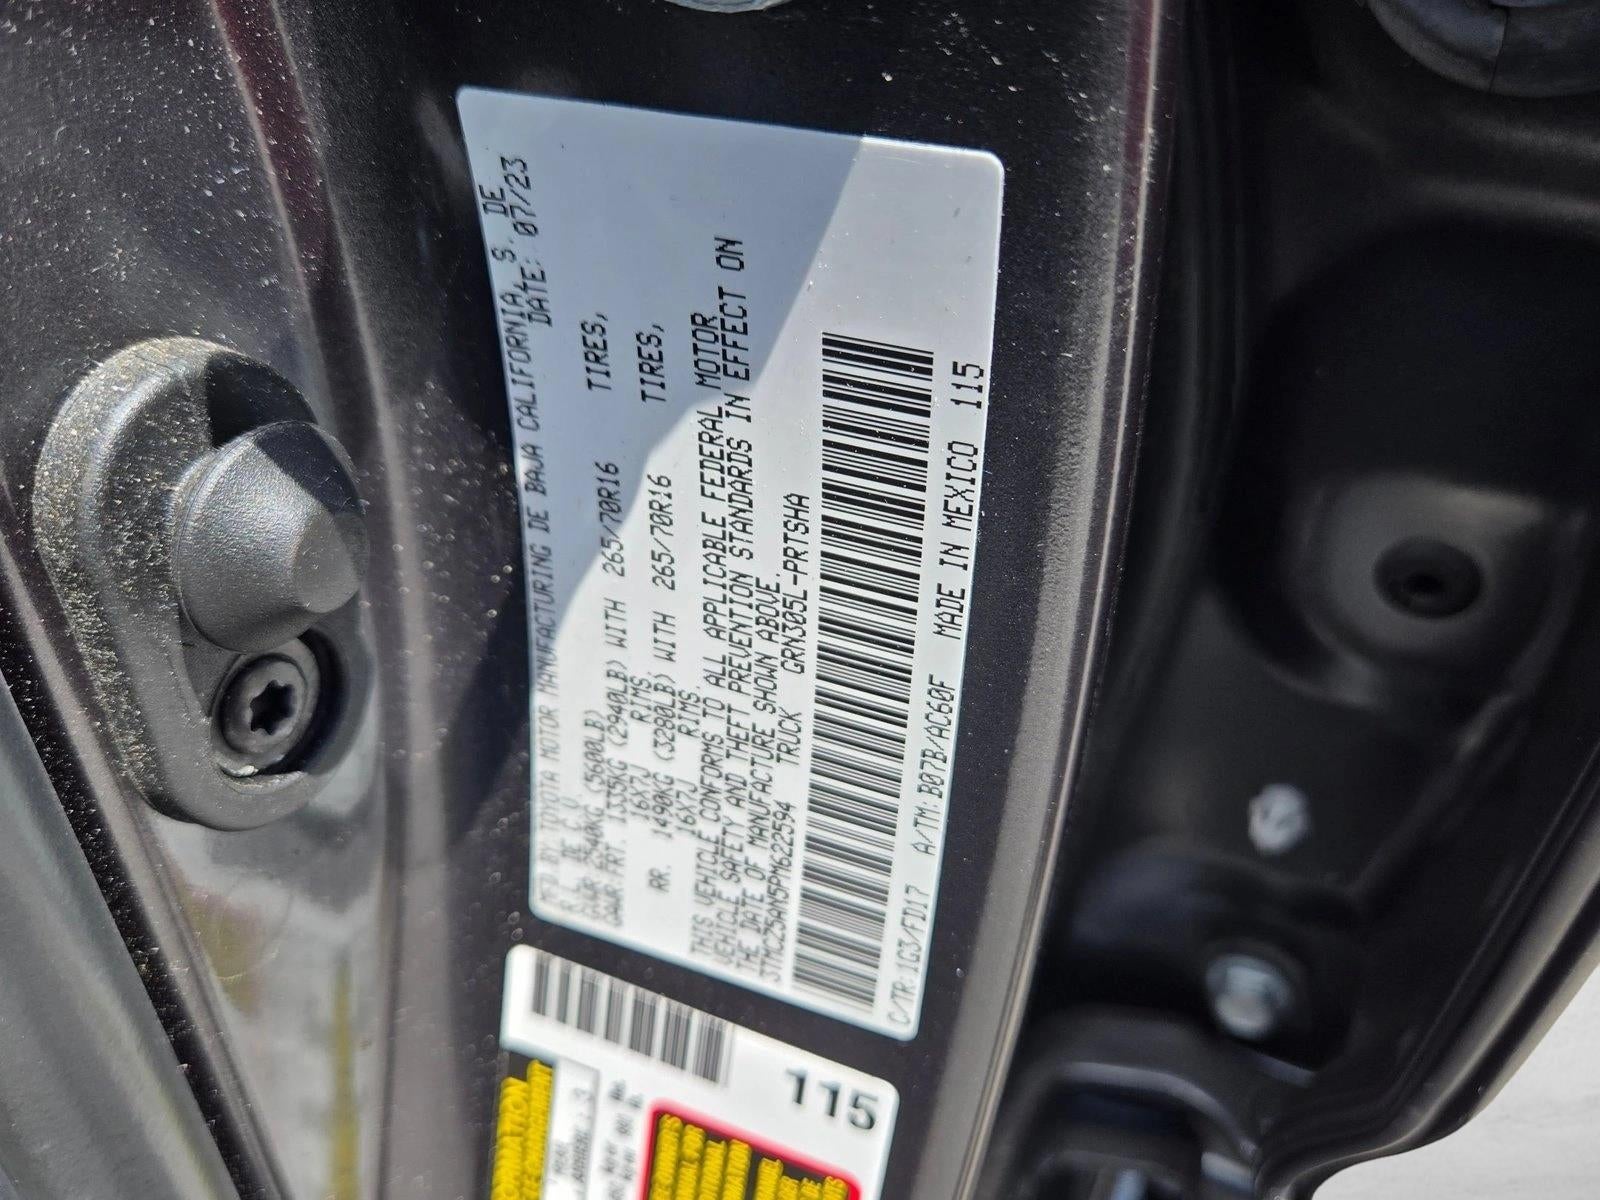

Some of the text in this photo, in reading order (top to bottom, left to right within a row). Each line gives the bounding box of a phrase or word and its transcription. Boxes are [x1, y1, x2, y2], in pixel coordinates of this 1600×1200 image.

[478, 184, 510, 218] DE
[491, 238, 517, 263] S.
[500, 156, 552, 328] DATE: 07/23
[499, 283, 539, 432] CALIFORNIA,
[580, 312, 611, 391] TIRES,
[635, 324, 666, 403] TIRES,
[950, 361, 983, 410] 115
[518, 443, 547, 496] BAJA
[941, 440, 978, 532] MEXICO
[527, 506, 550, 533] DE
[595, 462, 625, 577] 265/70R16
[647, 474, 675, 590] 265/70R16
[939, 541, 970, 571] IN
[529, 546, 558, 697] MANUFACTURING
[603, 597, 627, 648] WITH
[653, 611, 676, 662] WITH
[689, 312, 728, 956] THIS VEHICLE CONFORMS TO ALL APPLICABLE FEDERAL MOTOR
[713, 235, 753, 966] VEHICLE SAFETY AND THEFT PREVENTION STANDARDS IN EFFECT ON
[932, 583, 965, 640] MADE
[538, 704, 560, 760] MOTOR
[605, 660, 628, 747] (2940LB)
[652, 673, 676, 762] (3280LB)
[759, 492, 810, 982] 3TMCZ5AN5PM622594 TRUCK GRN305L-PRTSHA
[582, 710, 606, 793] (5600LB)
[629, 671, 652, 821] 16X7J RIMS.
[674, 685, 701, 836] 16X7J RIMS.
[736, 572, 780, 972] THE DATE OF MANUFACTURE SHOWN ABOVE.
[539, 770, 560, 832] TOYOTA
[605, 758, 628, 824] 1335KG
[652, 772, 675, 839] 1490KG
[784, 1068, 878, 1129] 115
